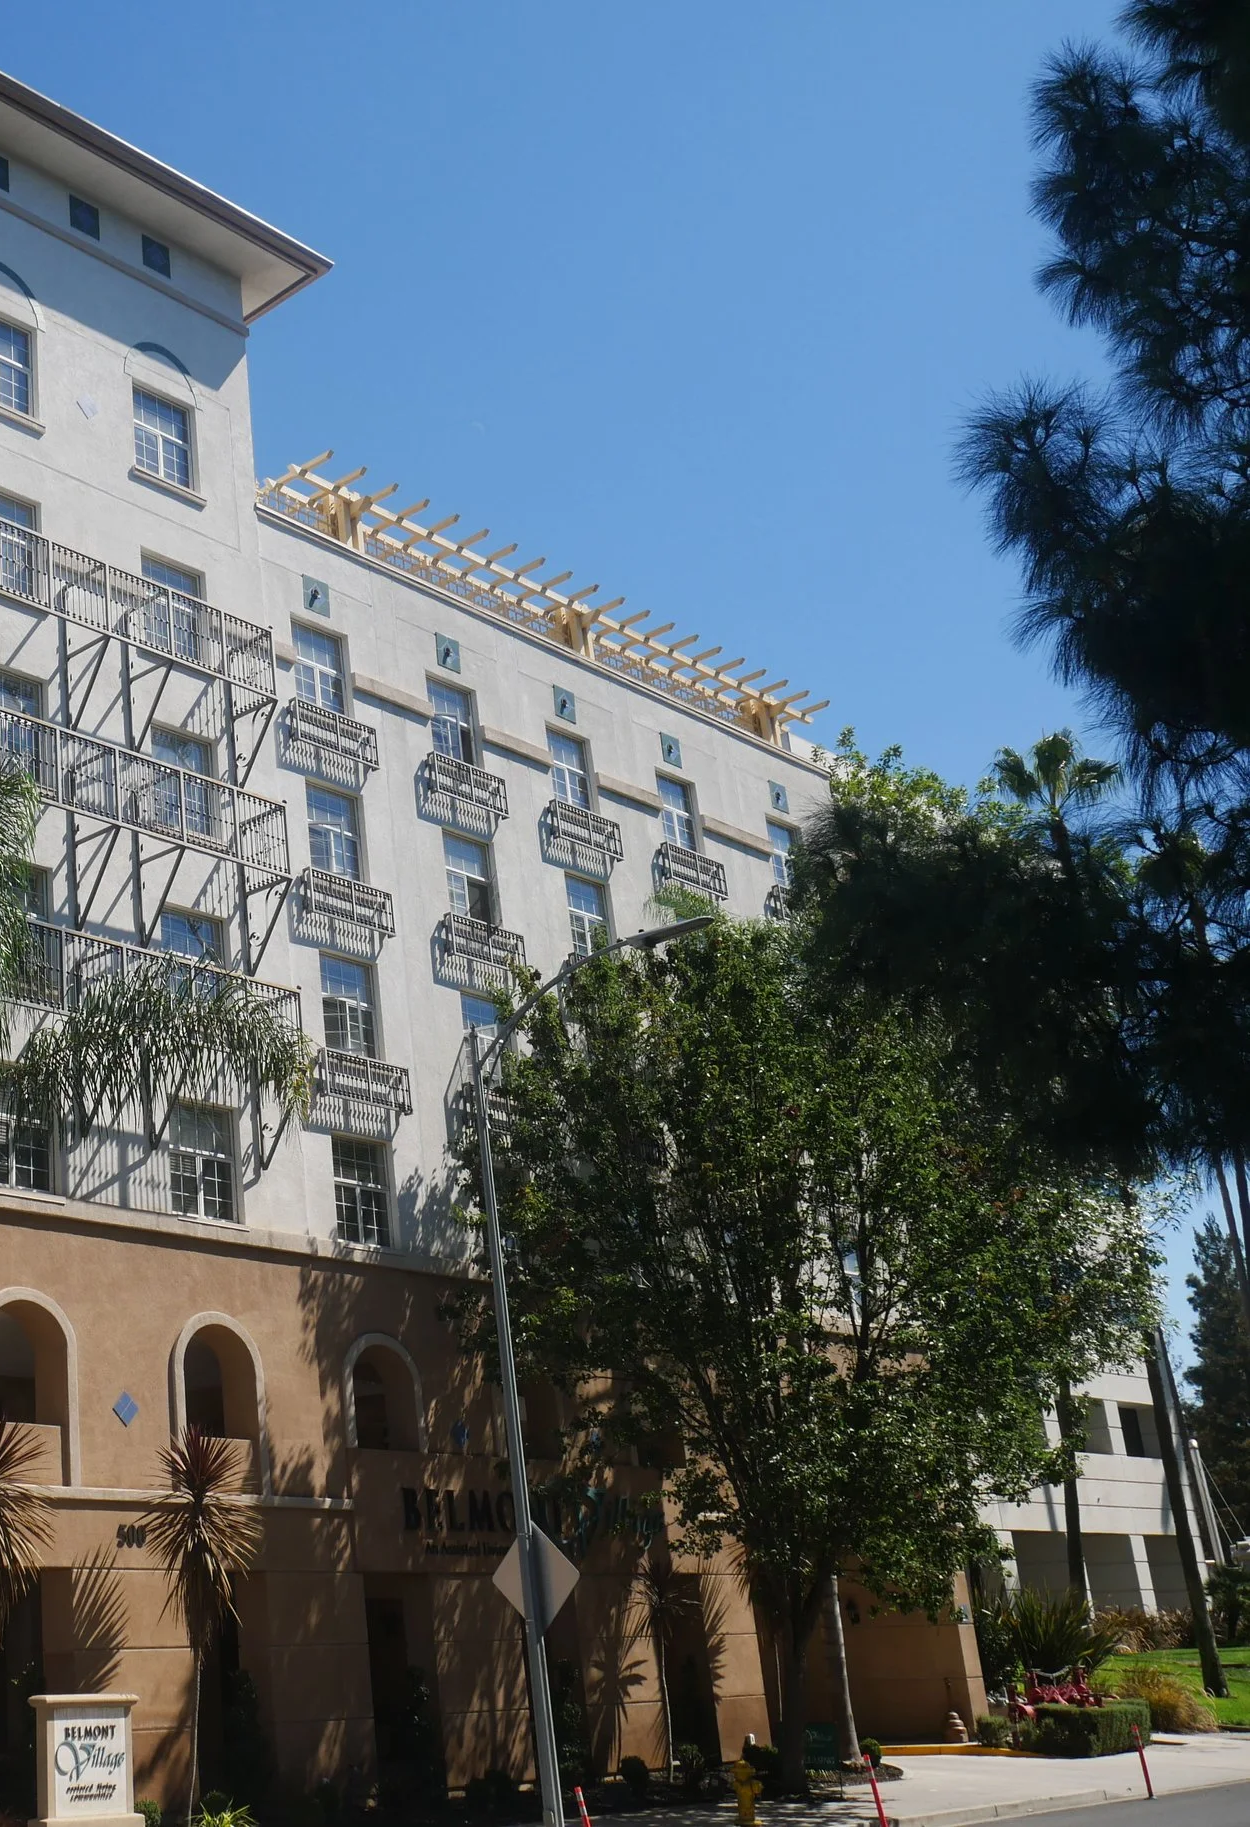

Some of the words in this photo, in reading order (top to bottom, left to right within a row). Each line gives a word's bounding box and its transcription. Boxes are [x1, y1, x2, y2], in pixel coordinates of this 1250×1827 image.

[116, 1524, 146, 1548] 500
[64, 1725, 116, 1741] BELMONT
[54, 1740, 125, 1783] Village
